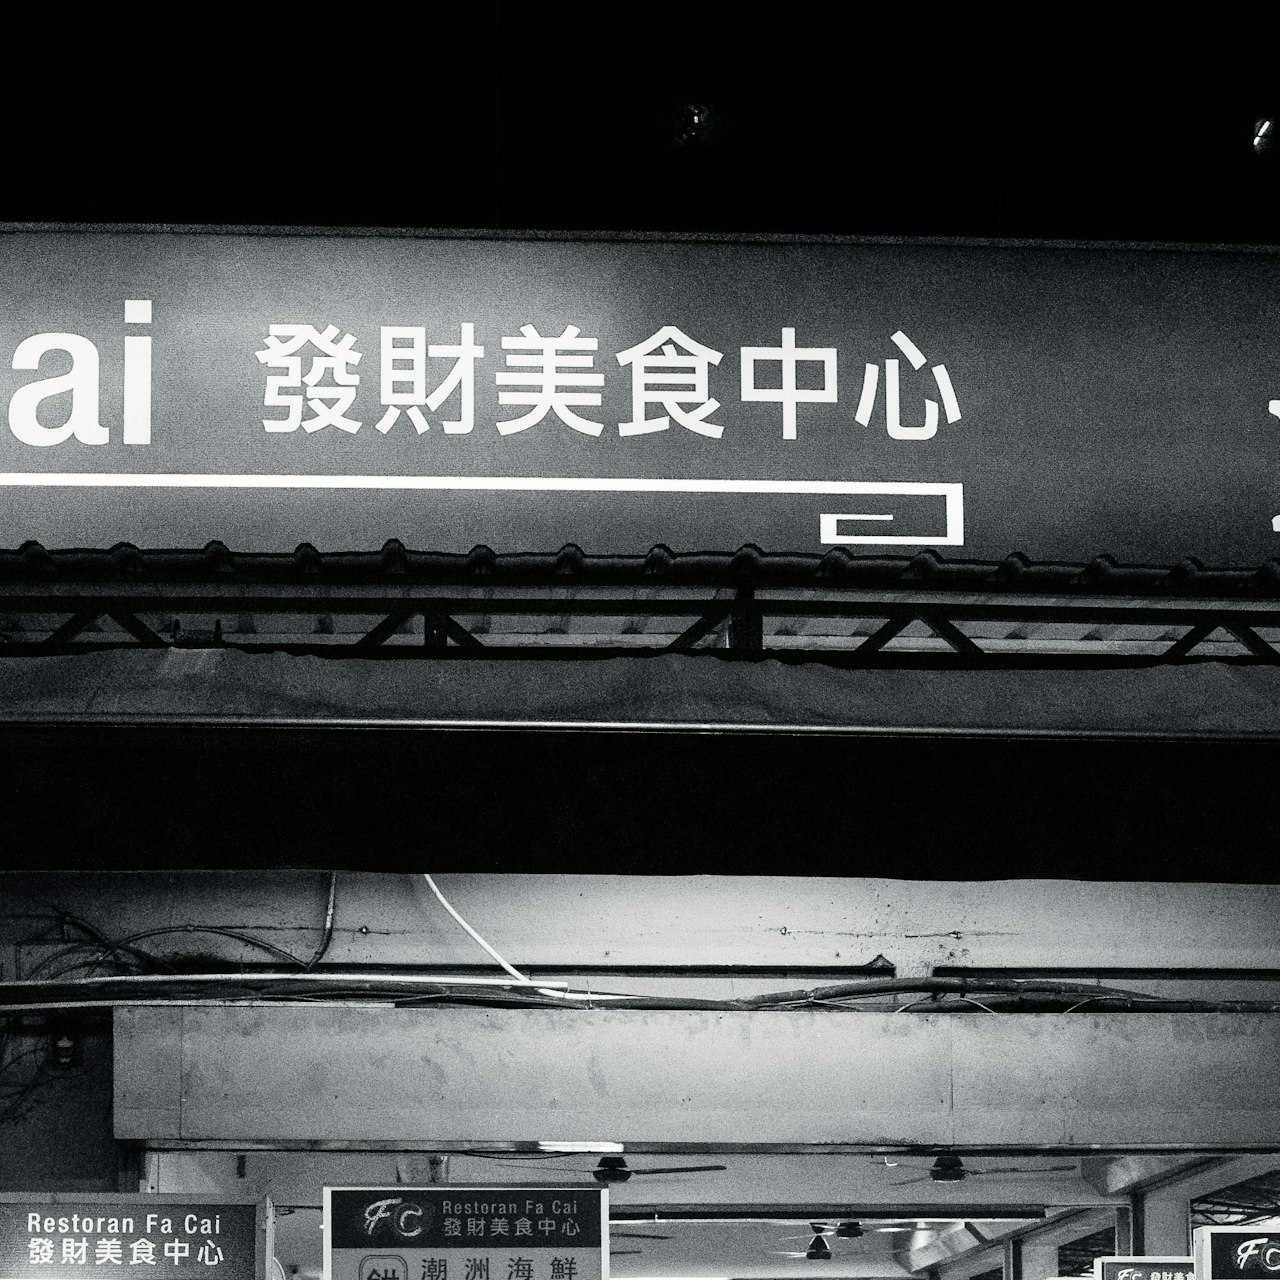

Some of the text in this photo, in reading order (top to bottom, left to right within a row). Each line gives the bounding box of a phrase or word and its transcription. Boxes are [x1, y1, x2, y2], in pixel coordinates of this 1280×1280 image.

[254, 322, 963, 441] 發財美食中心
[442, 1200, 518, 1215] Restoran
[526, 1201, 544, 1215] Fa
[552, 1201, 577, 1214] Cai
[27, 1213, 134, 1234] Restoran
[146, 1214, 173, 1234] Fa
[184, 1214, 221, 1234] Cai
[443, 1218, 580, 1236] 發財美食中心
[27, 1238, 224, 1266] 發財美食中心
